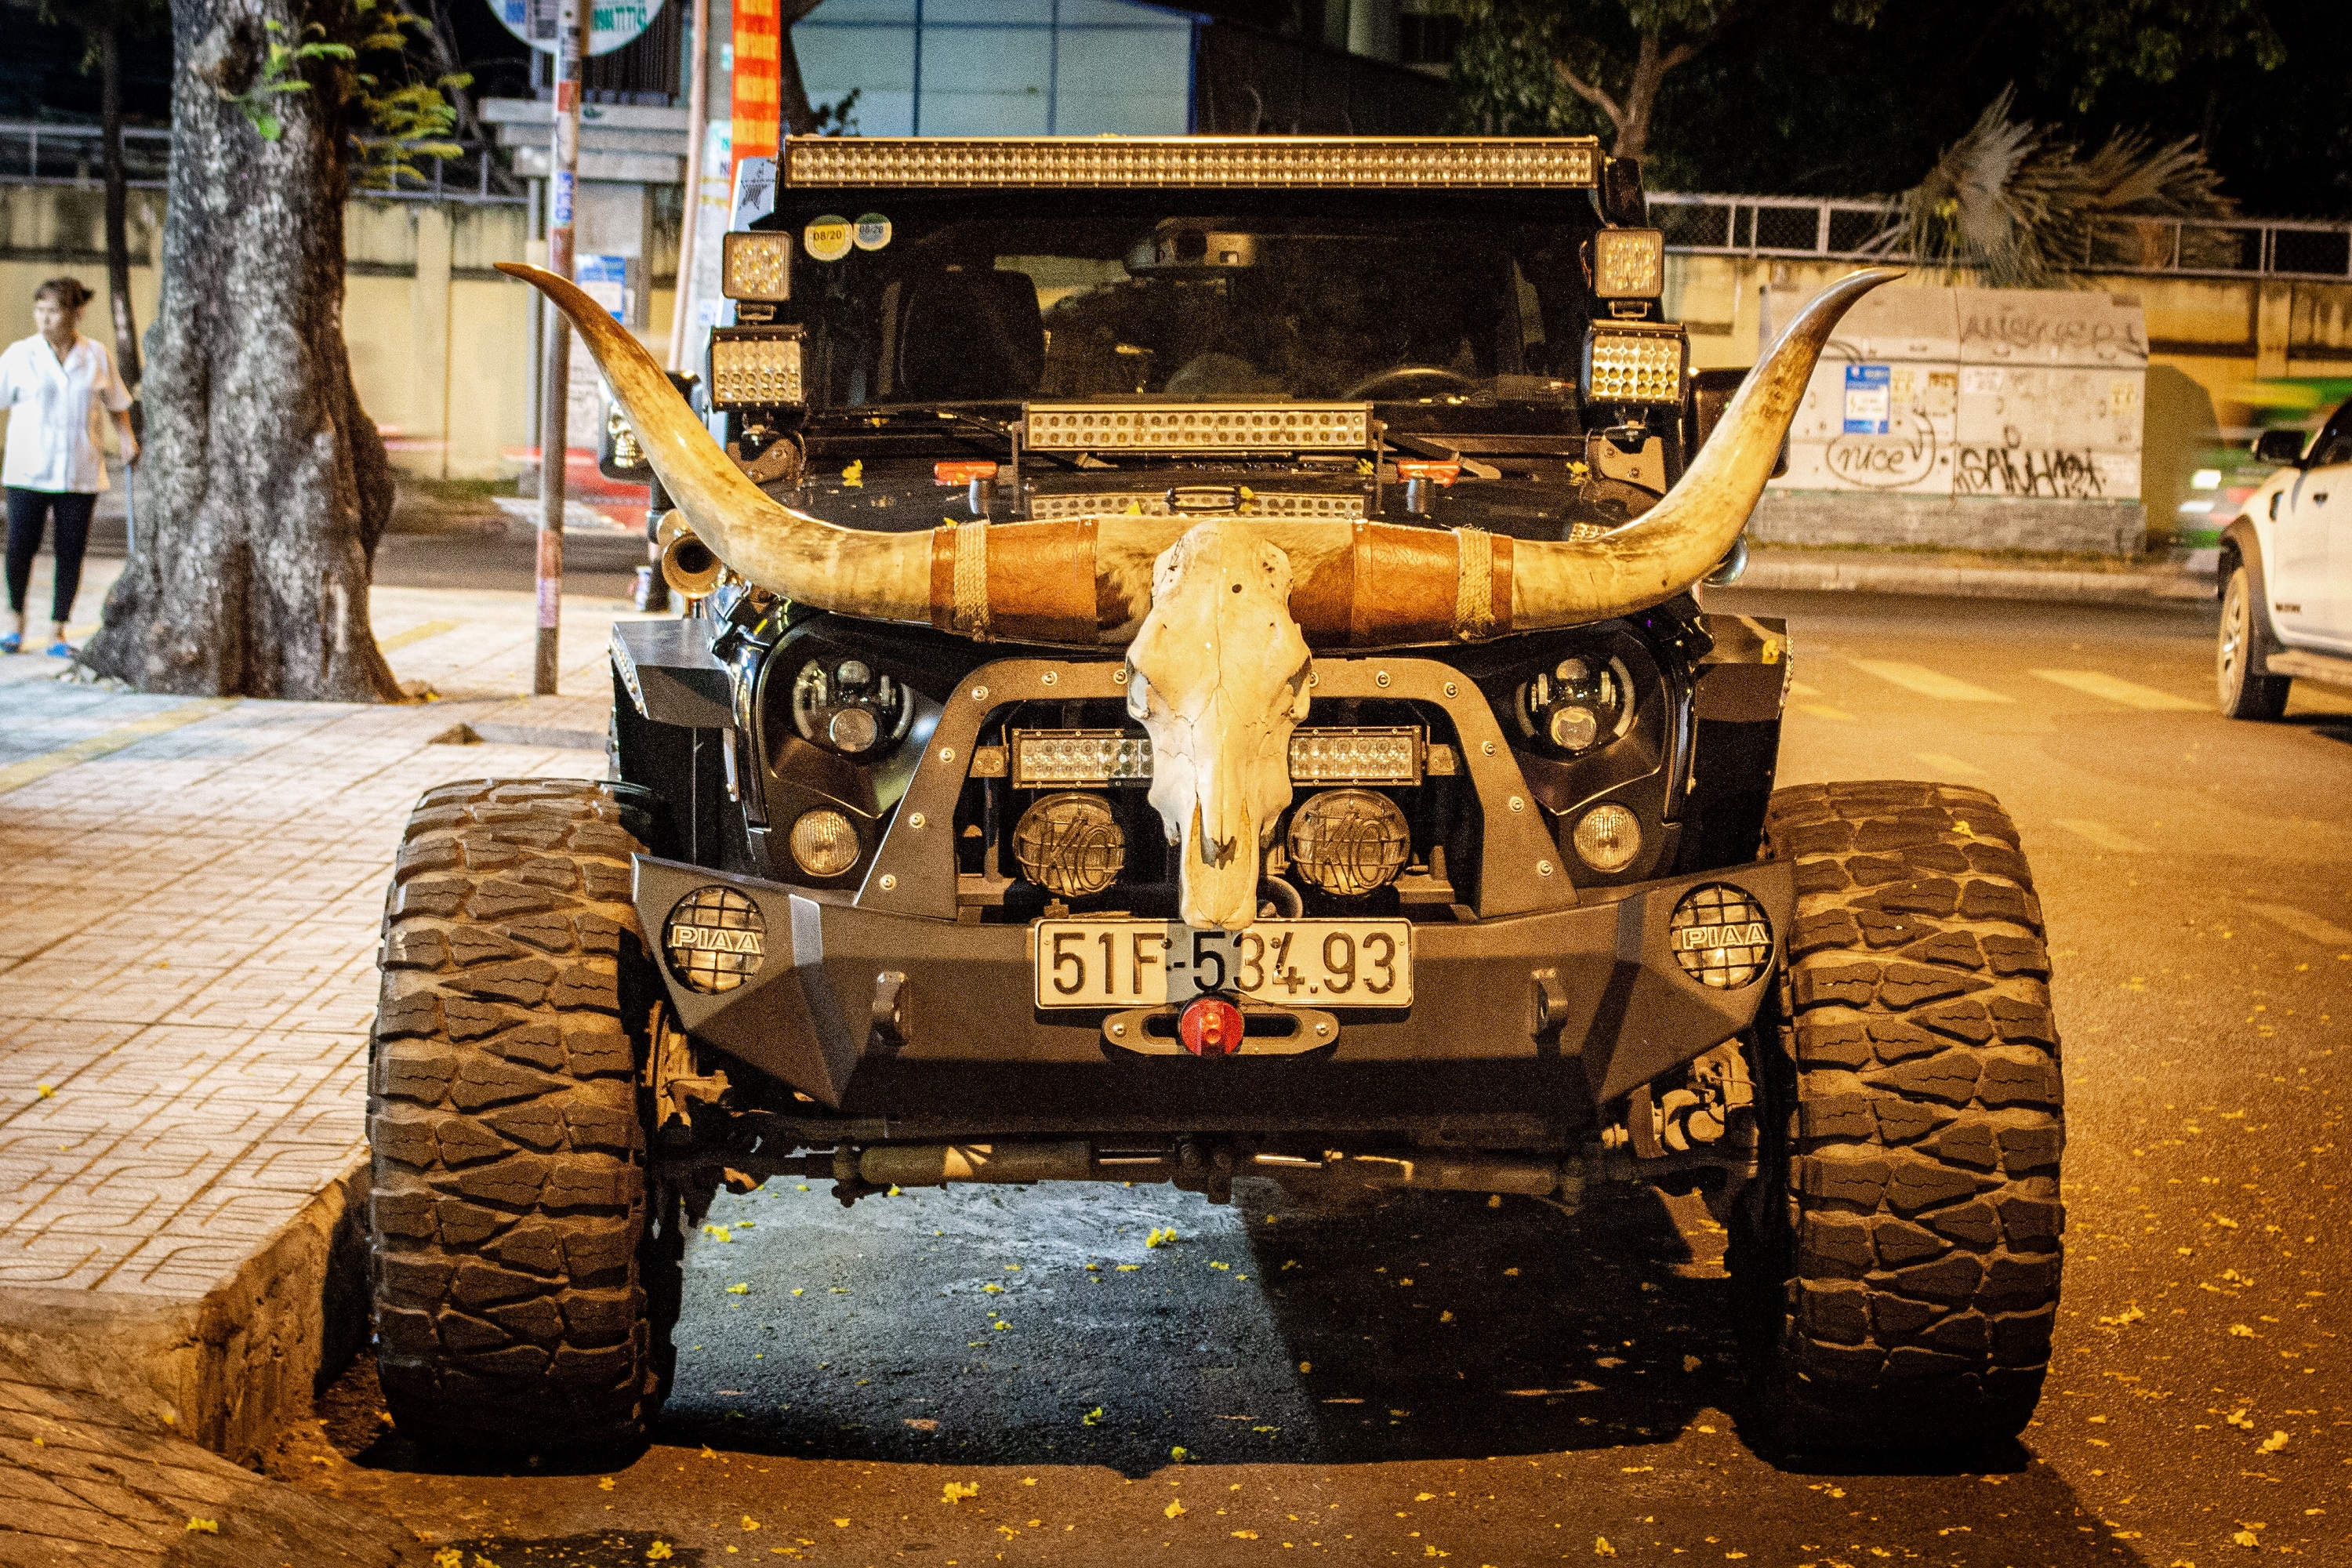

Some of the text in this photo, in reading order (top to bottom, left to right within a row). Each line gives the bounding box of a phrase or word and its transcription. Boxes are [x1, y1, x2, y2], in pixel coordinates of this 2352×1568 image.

[813, 230, 842, 241] 08/20
[672, 924, 761, 954] PIAA
[1682, 923, 1769, 950] PIAA
[1053, 931, 1396, 994] 51F-534.93
